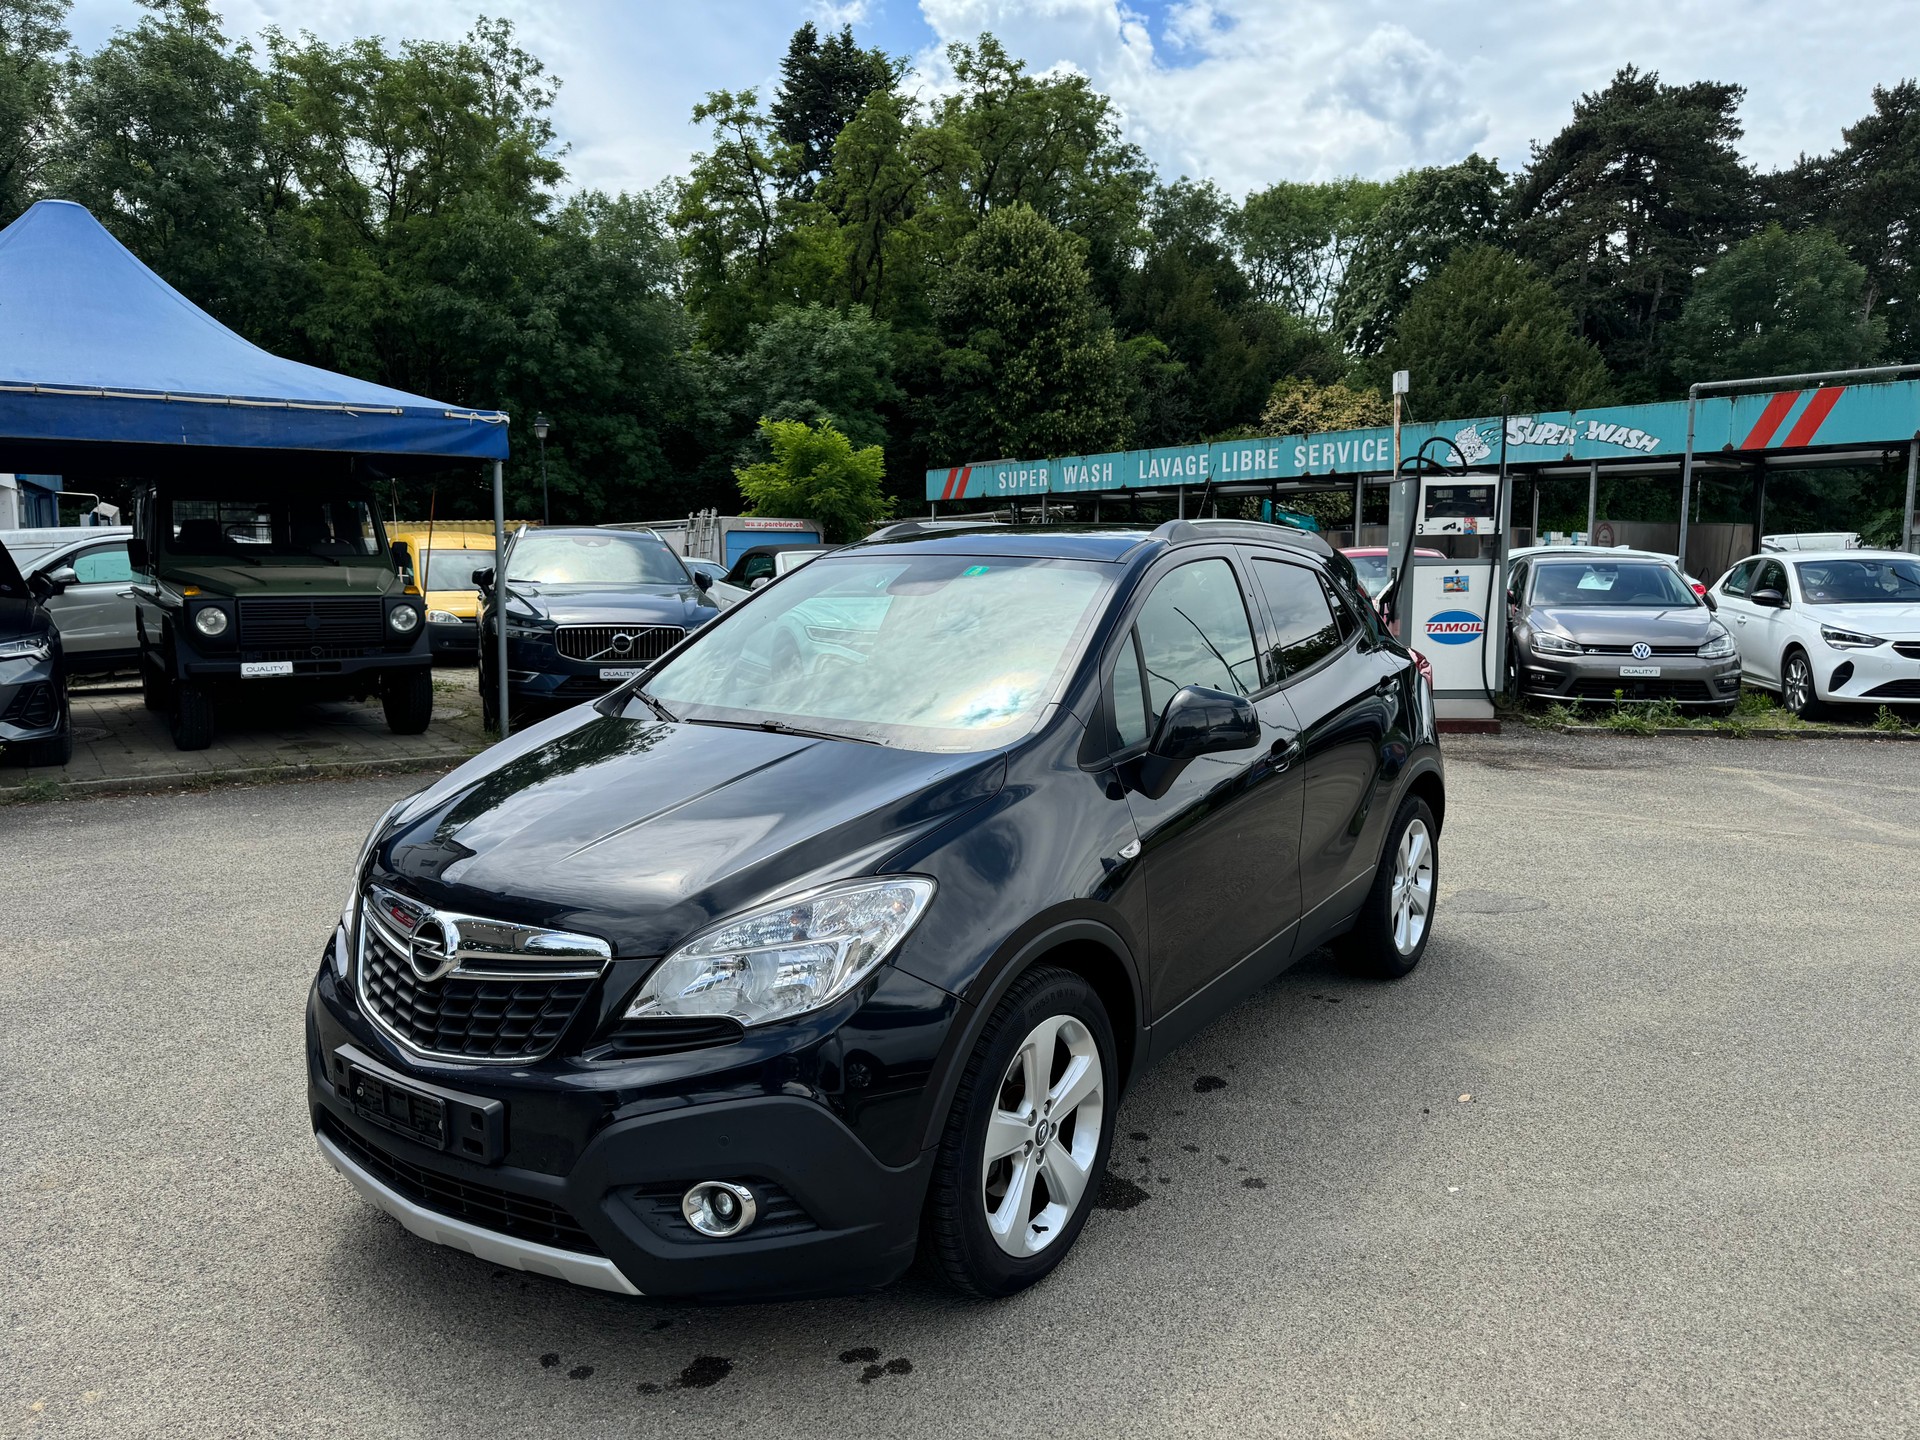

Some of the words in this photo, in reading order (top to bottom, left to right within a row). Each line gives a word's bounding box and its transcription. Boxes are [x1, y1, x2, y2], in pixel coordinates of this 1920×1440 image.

[1504, 417, 1577, 446] SUPER
[1587, 420, 1661, 453] WASH
[998, 468, 1048, 489] SUPER
[1063, 463, 1112, 485] WASH
[1139, 454, 1208, 479] LAVAGE
[1222, 447, 1279, 473] LIBRE
[1294, 438, 1389, 468] SERVICE
[1401, 482, 1406, 495] 3
[1417, 523, 1424, 534] 3
[1425, 623, 1484, 632] TAMOIL
[245, 665, 284, 673] QUALITY
